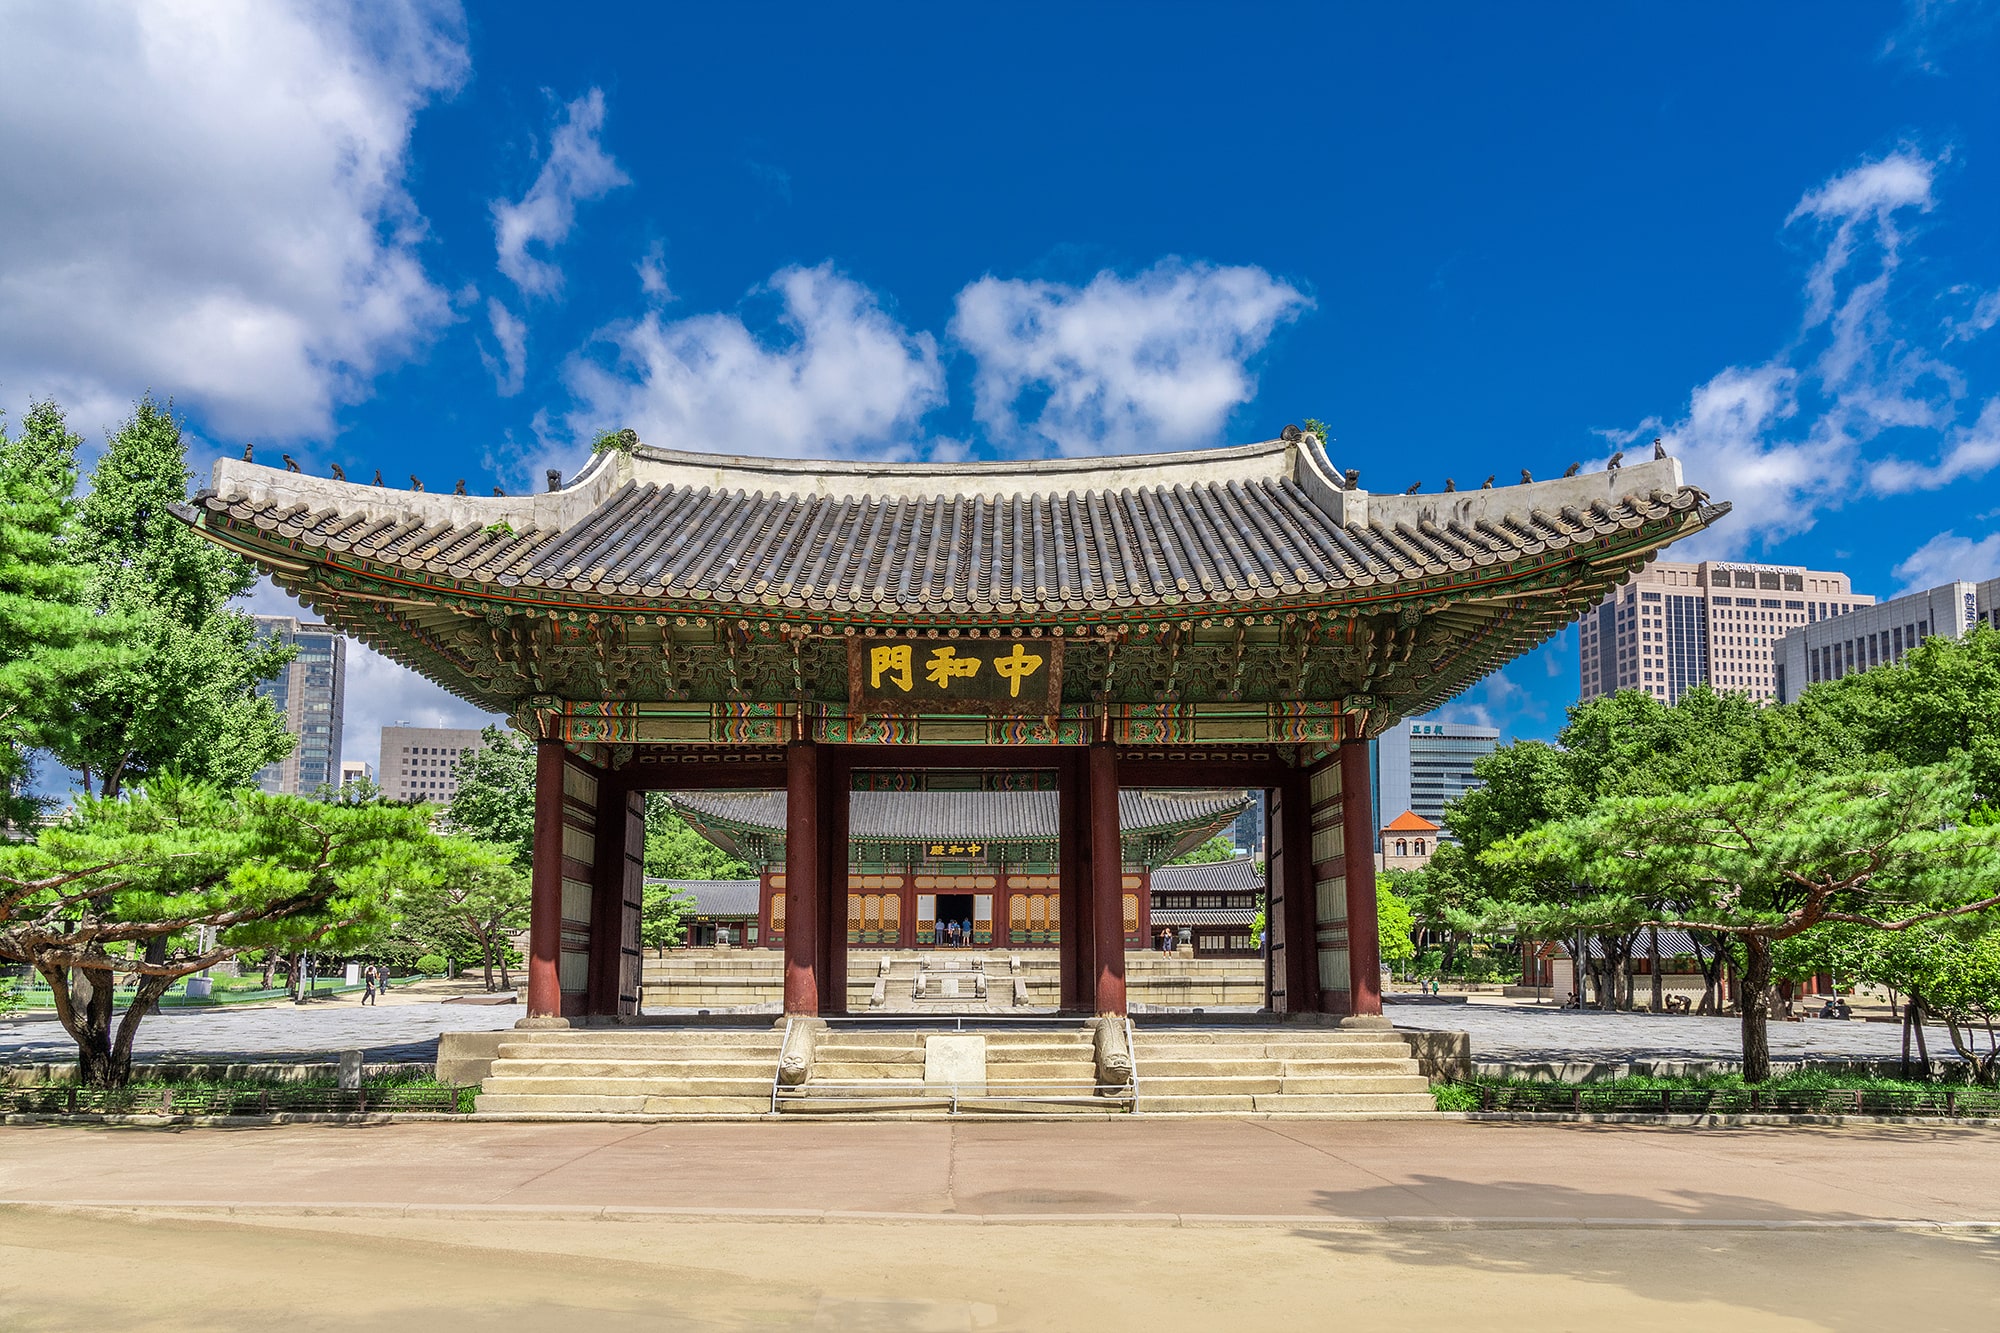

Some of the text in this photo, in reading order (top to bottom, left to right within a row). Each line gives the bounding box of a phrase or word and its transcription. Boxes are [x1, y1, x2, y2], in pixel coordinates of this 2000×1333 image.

[1751, 564, 1777, 573] FINANCE
[1777, 566, 1800, 575] CENTER
[870, 643, 1043, 698] 中和門
